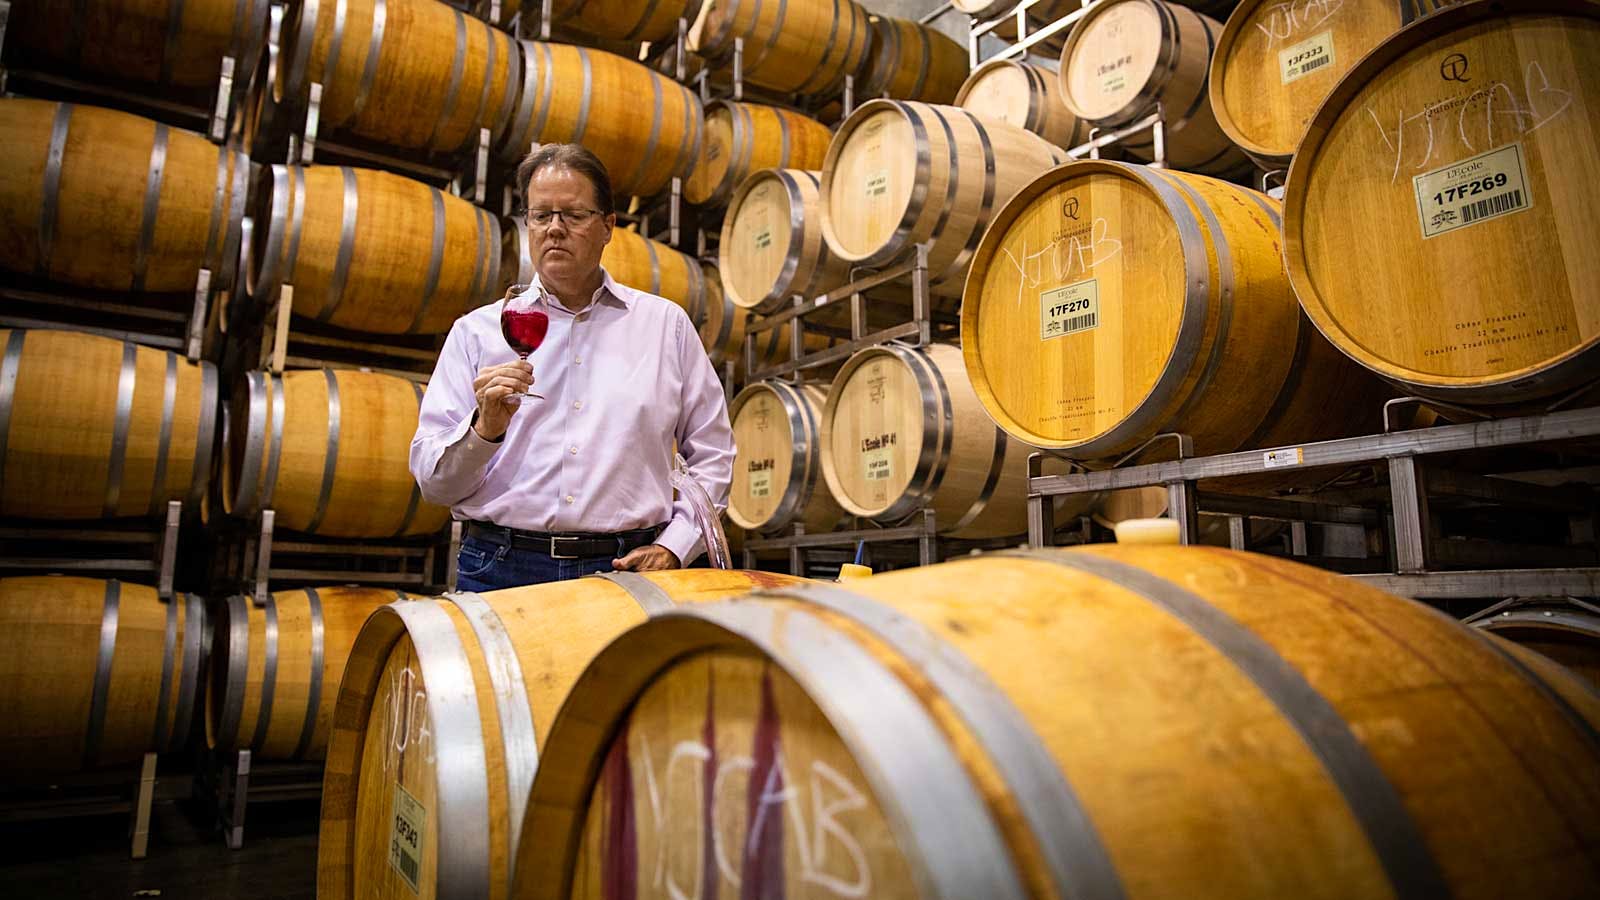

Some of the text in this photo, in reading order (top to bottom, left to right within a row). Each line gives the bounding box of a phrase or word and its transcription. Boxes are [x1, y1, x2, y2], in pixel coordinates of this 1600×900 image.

[1287, 45, 1324, 67] 13F333
[1433, 172, 1507, 206] 17F269
[1049, 298, 1090, 317] 17F270
[396, 814, 417, 848] 13F343
